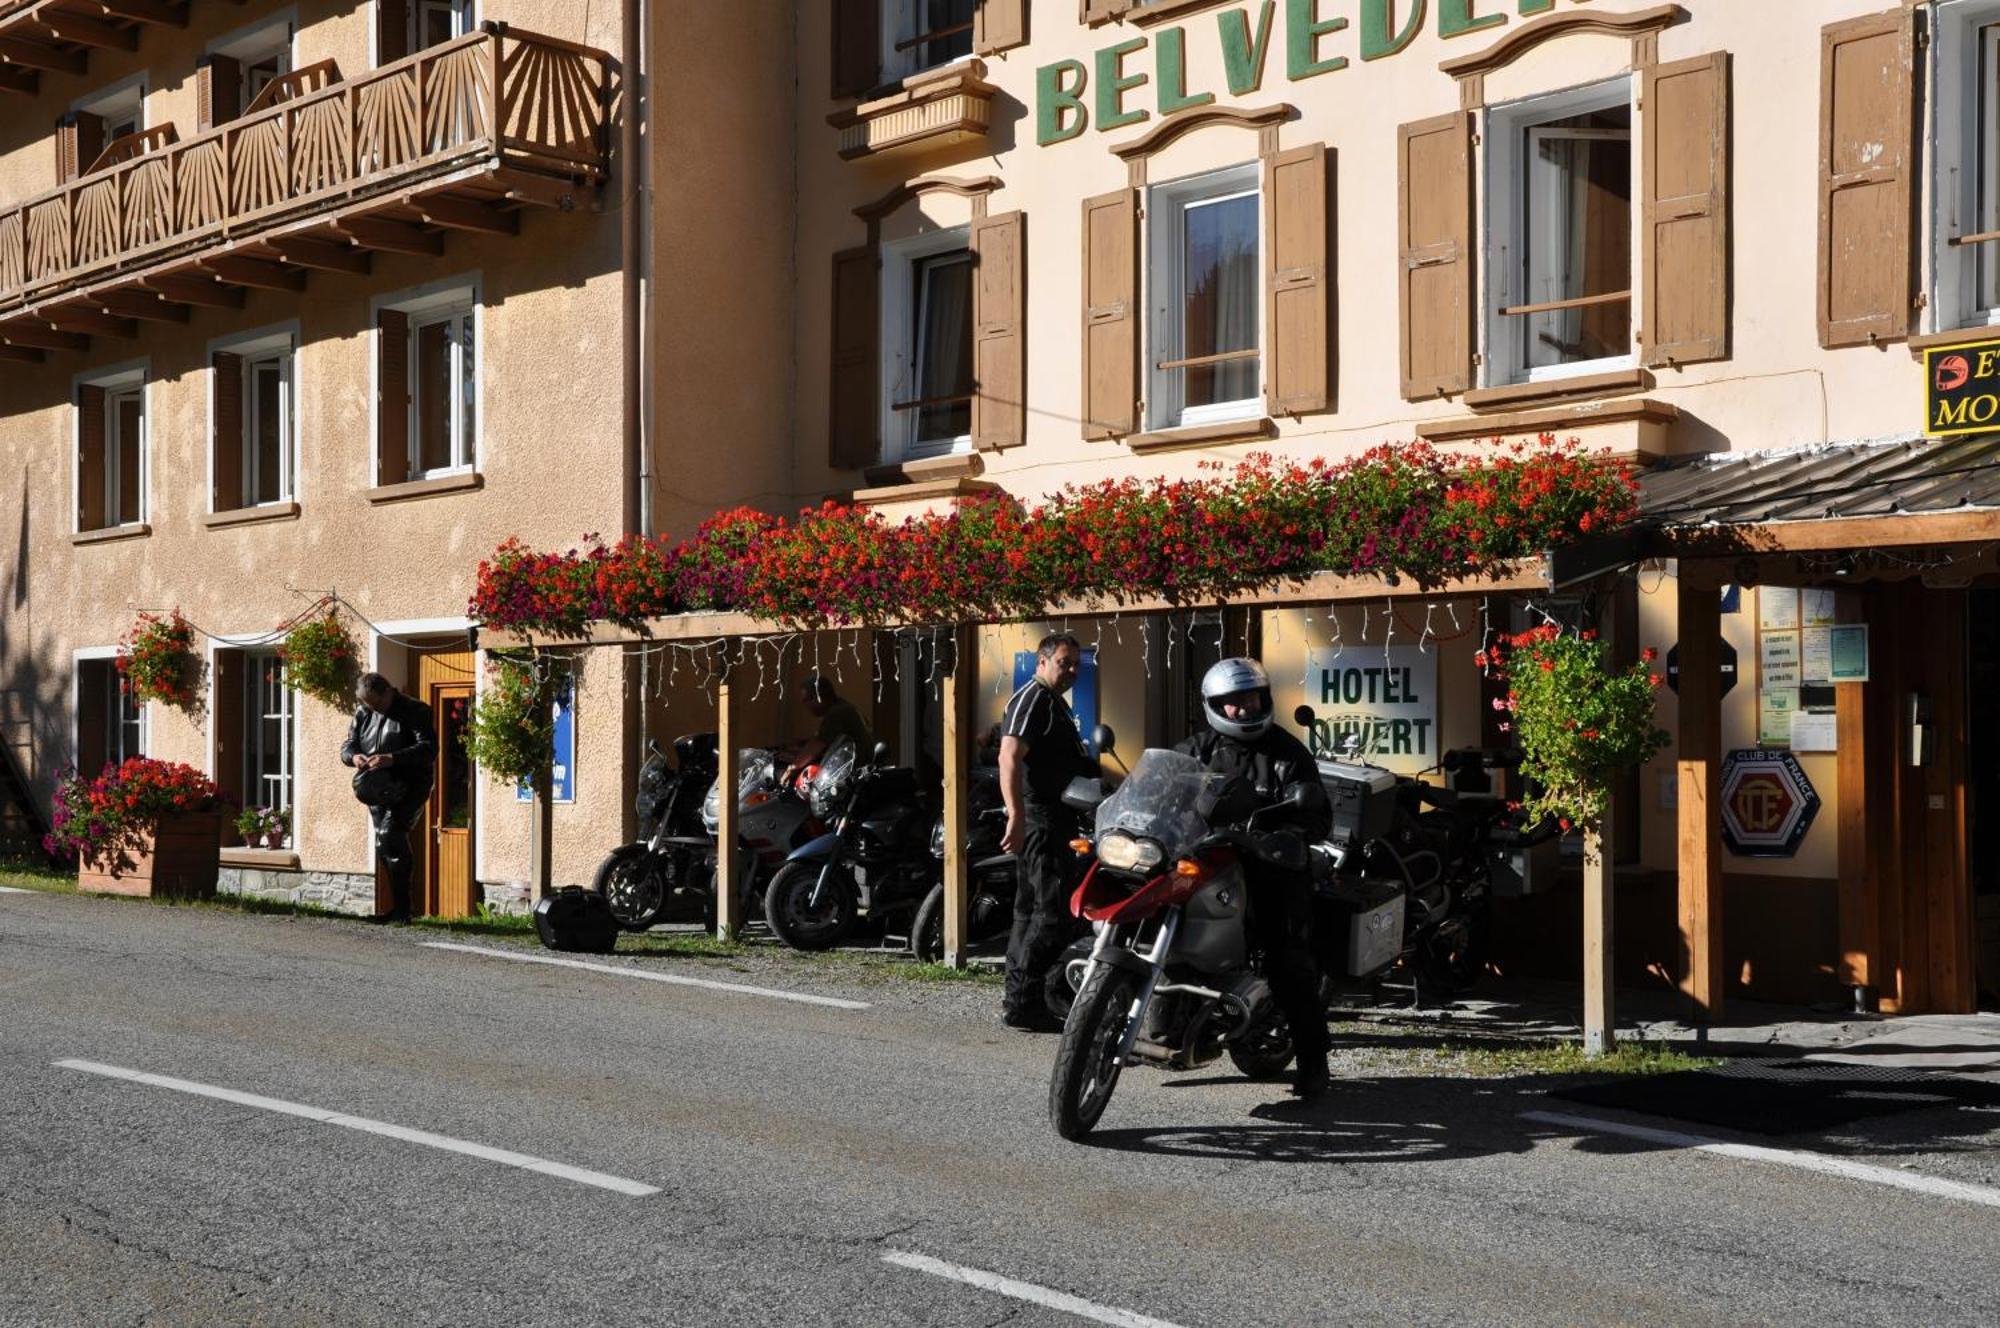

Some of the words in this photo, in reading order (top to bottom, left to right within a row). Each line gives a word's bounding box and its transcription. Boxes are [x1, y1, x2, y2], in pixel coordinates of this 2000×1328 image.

[1036, 0, 1588, 146] BELVED
[1974, 348, 2000, 378] E
[1934, 394, 2000, 426] MO
[1321, 667, 1418, 704] HOTEL
[1736, 751, 1765, 761] CLUB
[1768, 751, 1783, 760] DE
[1785, 758, 1815, 801] FRANCE
